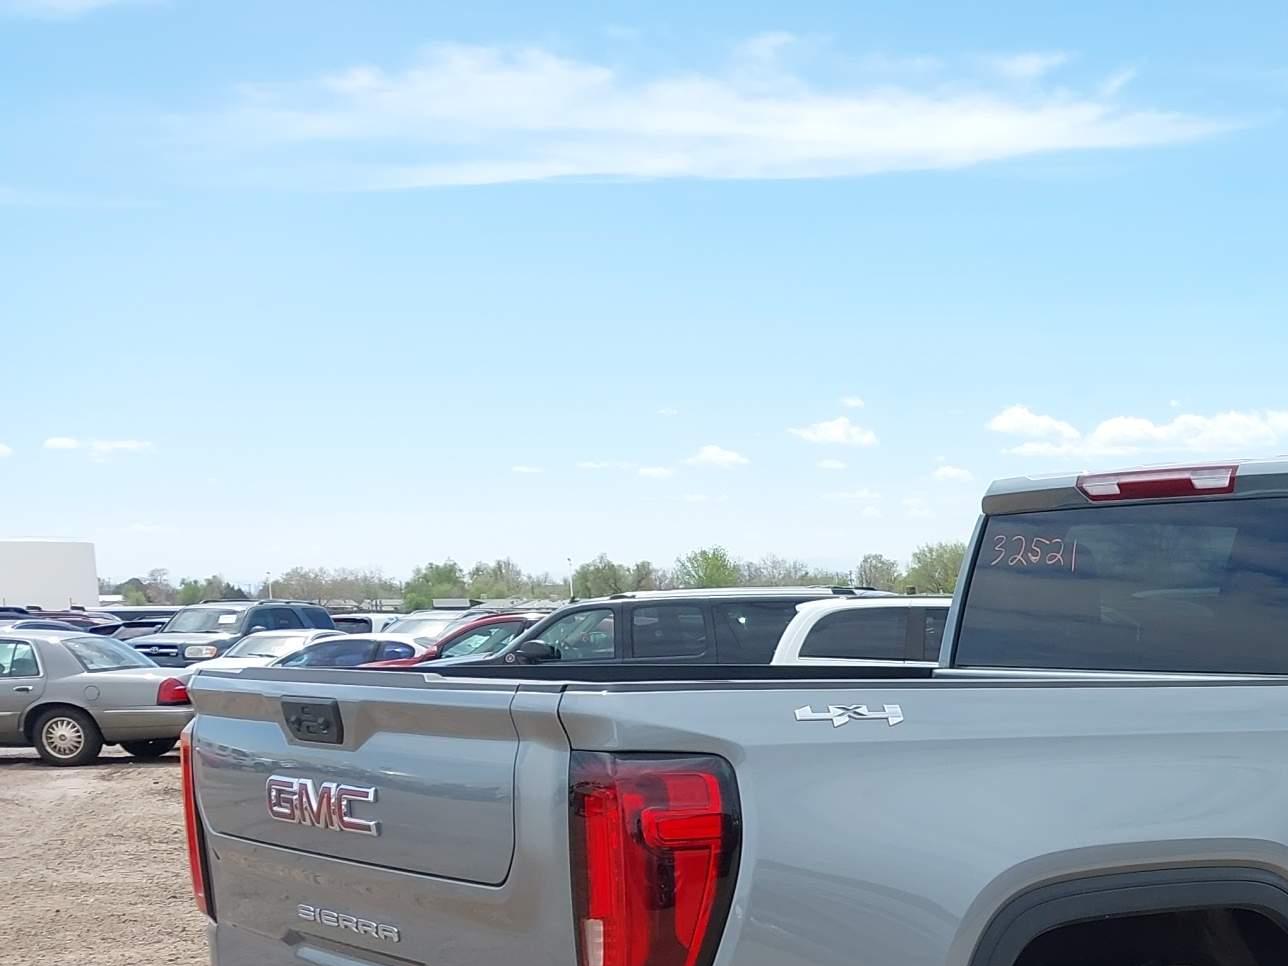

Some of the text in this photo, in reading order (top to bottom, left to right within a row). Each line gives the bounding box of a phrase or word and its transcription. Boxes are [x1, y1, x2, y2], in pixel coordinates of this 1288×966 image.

[991, 535, 1078, 573] 32521
[266, 775, 381, 836] GMC
[297, 903, 401, 943] SIERRA
